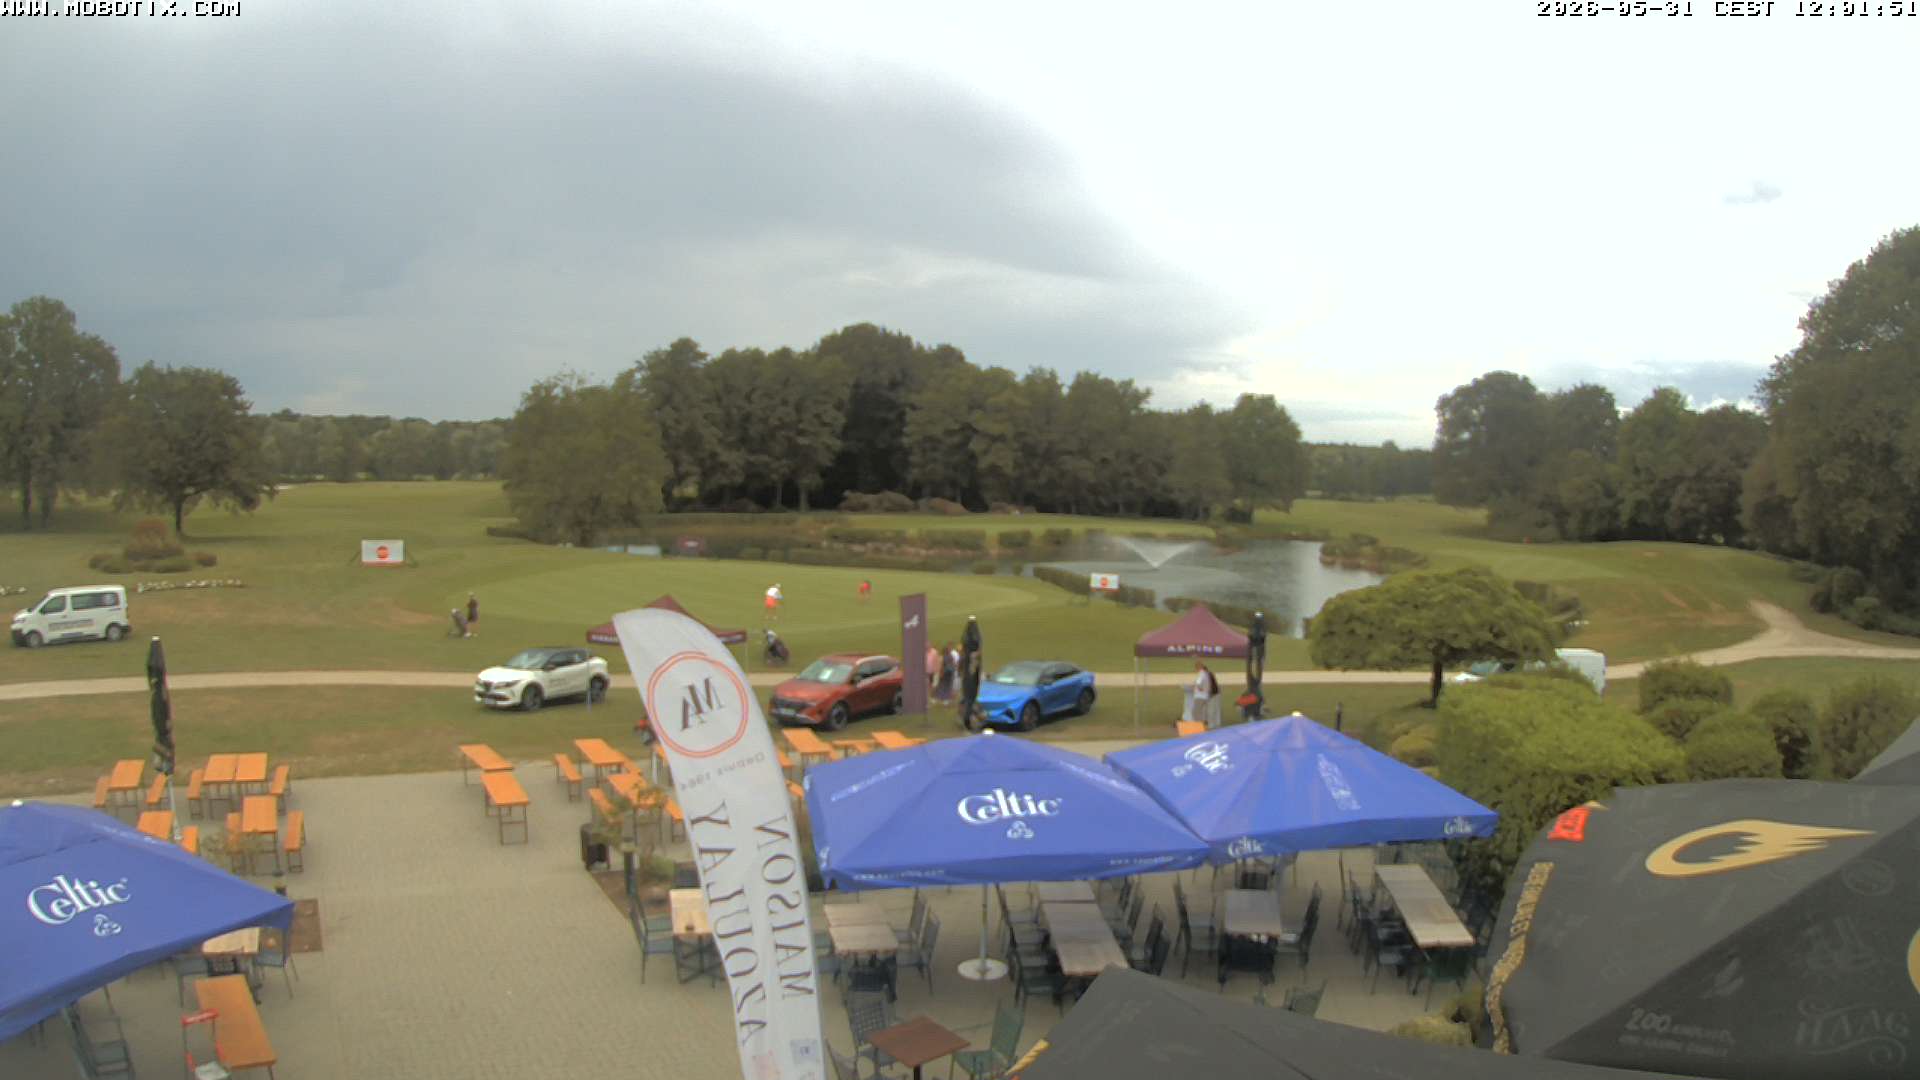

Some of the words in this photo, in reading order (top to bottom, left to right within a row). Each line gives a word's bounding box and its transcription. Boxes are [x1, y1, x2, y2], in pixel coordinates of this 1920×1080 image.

[1167, 645, 1223, 654] ALPINE
[957, 787, 1062, 826] Celtic
[27, 874, 131, 925] Celtic
